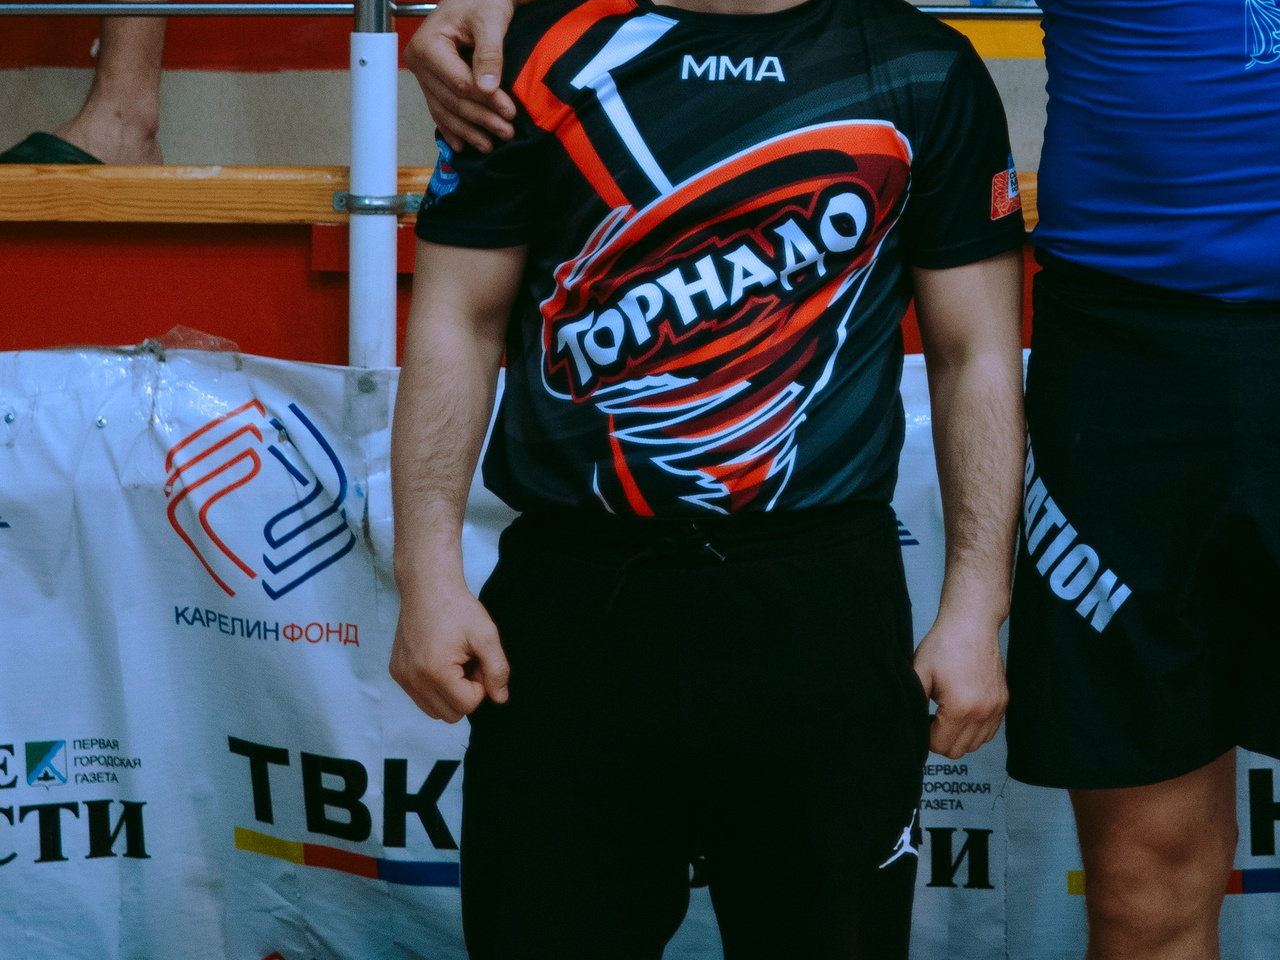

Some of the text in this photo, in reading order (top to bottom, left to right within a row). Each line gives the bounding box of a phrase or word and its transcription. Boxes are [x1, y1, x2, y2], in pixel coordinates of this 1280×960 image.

[681, 54, 786, 83] MMA
[556, 191, 868, 386] ТОРНАДО
[73, 738, 119, 751] ПЕРВАЯ
[73, 755, 142, 769] ГОРОДСКАЯ
[74, 772, 119, 784] ГАЗЕТА
[228, 735, 461, 851] ТВК
